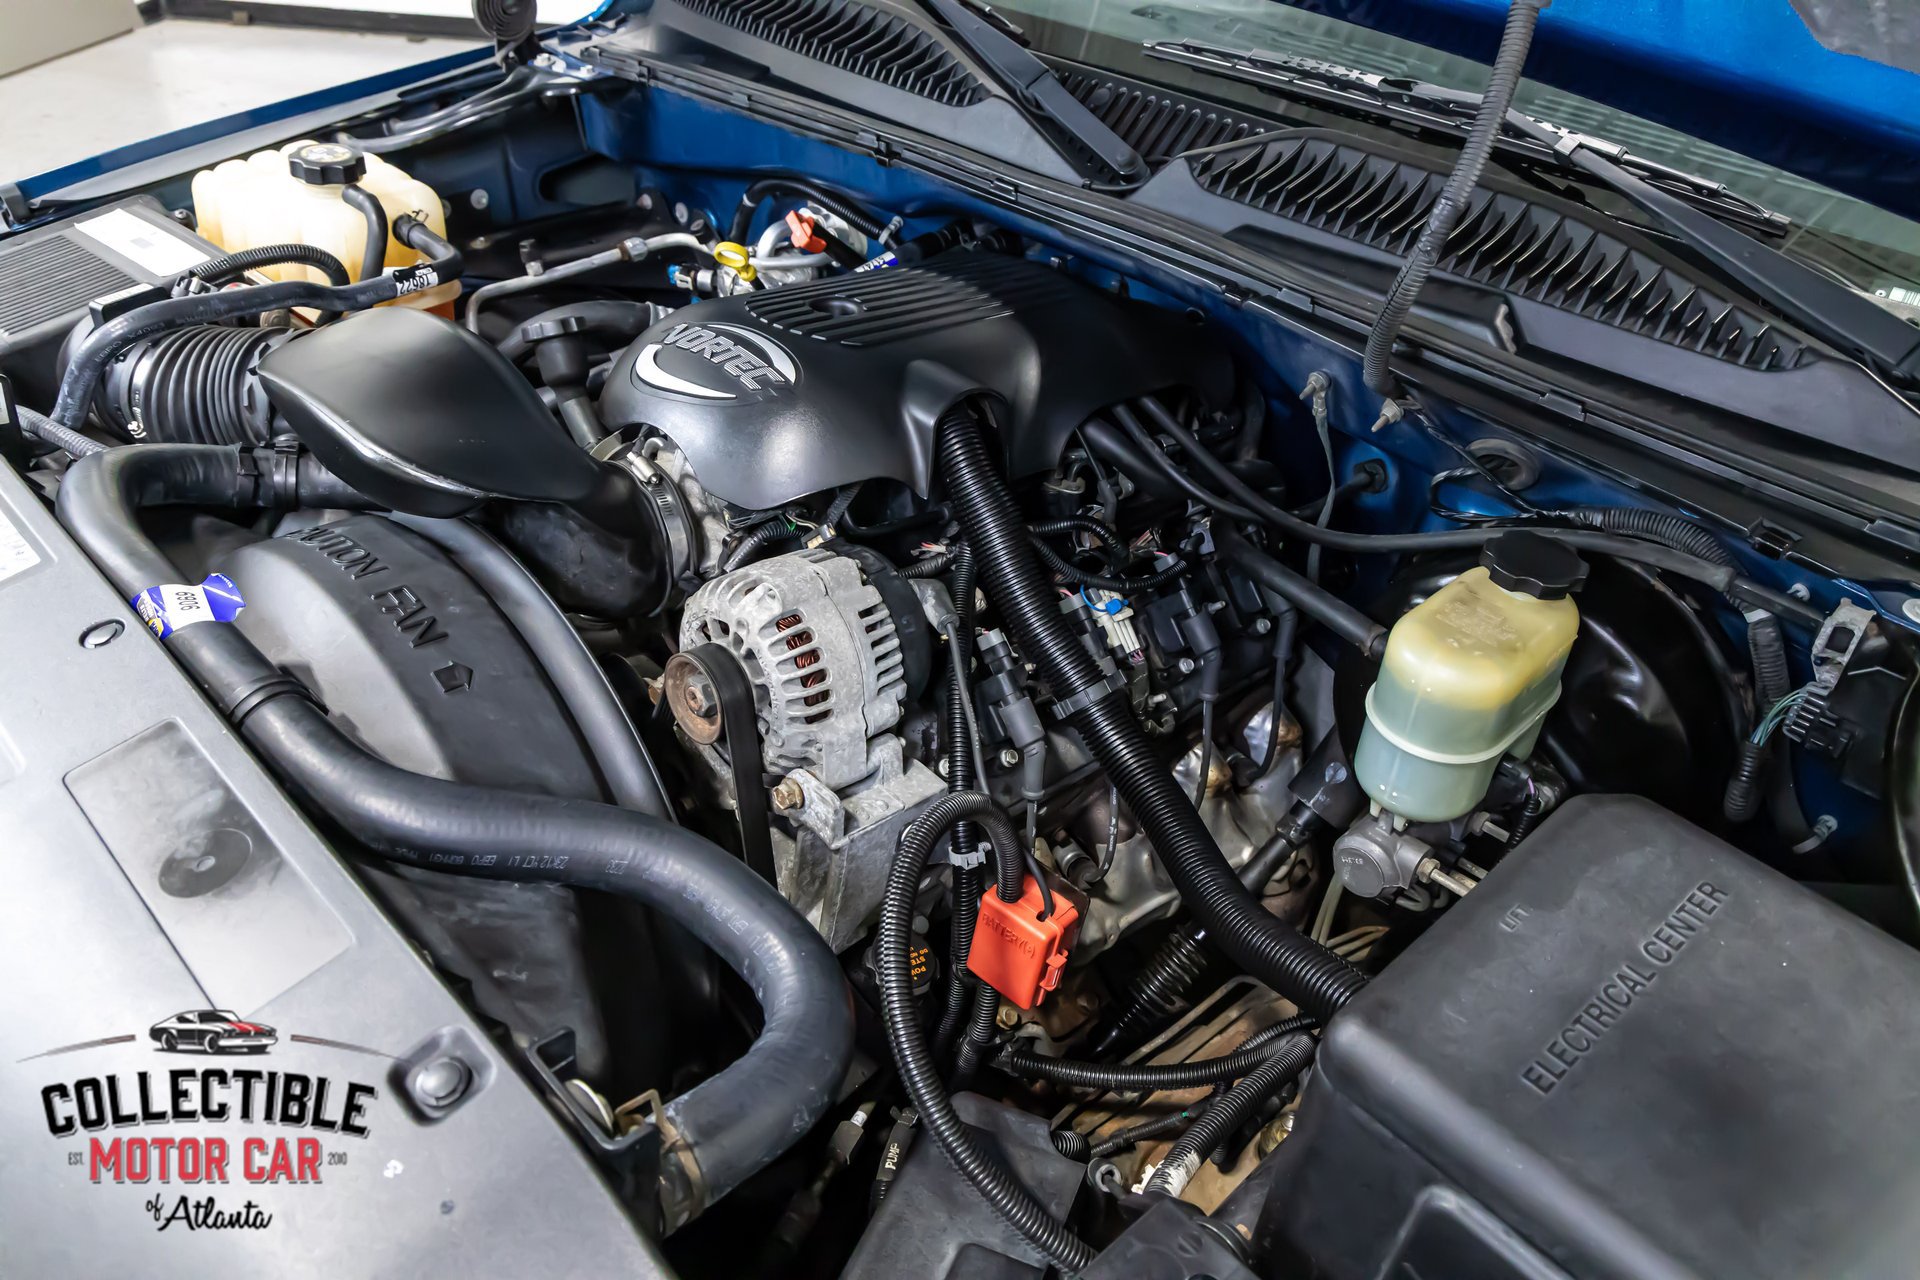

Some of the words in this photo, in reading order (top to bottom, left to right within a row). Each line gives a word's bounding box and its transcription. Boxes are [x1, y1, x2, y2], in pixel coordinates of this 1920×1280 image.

[664, 323, 786, 390] VORTEC
[284, 527, 390, 581] AUTION
[371, 585, 449, 649] FAN
[1521, 963, 1658, 1095] ELECTRICAL
[1640, 880, 1730, 967] CENTER
[884, 1142, 901, 1171] PUMP
